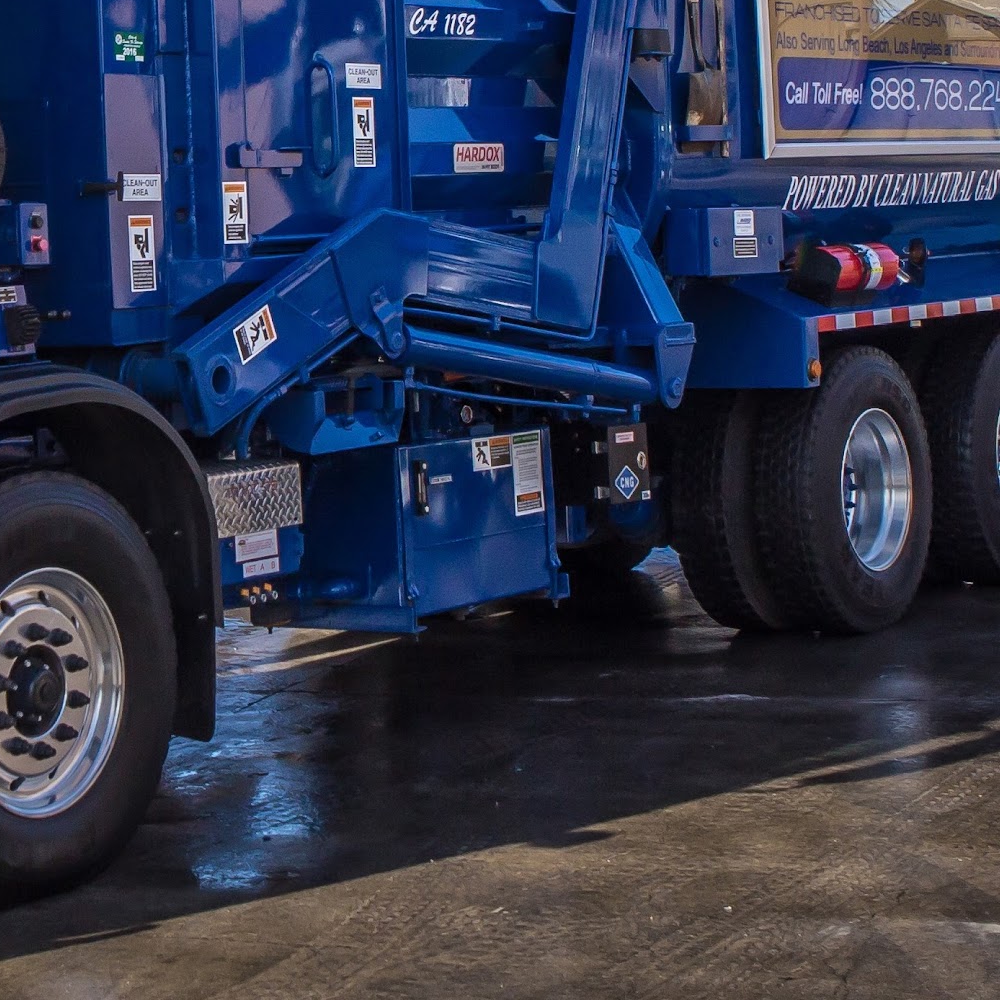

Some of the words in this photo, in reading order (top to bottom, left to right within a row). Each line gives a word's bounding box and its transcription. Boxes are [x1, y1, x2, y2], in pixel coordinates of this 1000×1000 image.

[775, 1, 861, 22] FRANCHISED
[863, 7, 879, 24] TO
[409, 7, 439, 35] CA
[444, 12, 476, 35] 1182
[122, 47, 137, 57] 2016
[776, 31, 798, 50] Also
[800, 32, 836, 56] Serving
[837, 34, 860, 56] Long
[862, 35, 892, 57] Beach,
[893, 37, 909, 55] Los
[911, 37, 942, 59] Angeles
[348, 67, 379, 77] CLEAN-OUT
[356, 77, 371, 85] AREA
[785, 81, 809, 105] Call
[812, 81, 832, 105] Toll
[834, 82, 864, 105] Free!
[456, 146, 500, 162] HARDOX
[132, 188, 149, 196] AREA
[782, 174, 857, 211] POWERED
[852, 174, 879, 208] BY
[873, 173, 922, 208] CLEAN
[916, 170, 976, 205] NATURAL
[974, 168, 1000, 202] GAS
[620, 475, 635, 489] CNG
